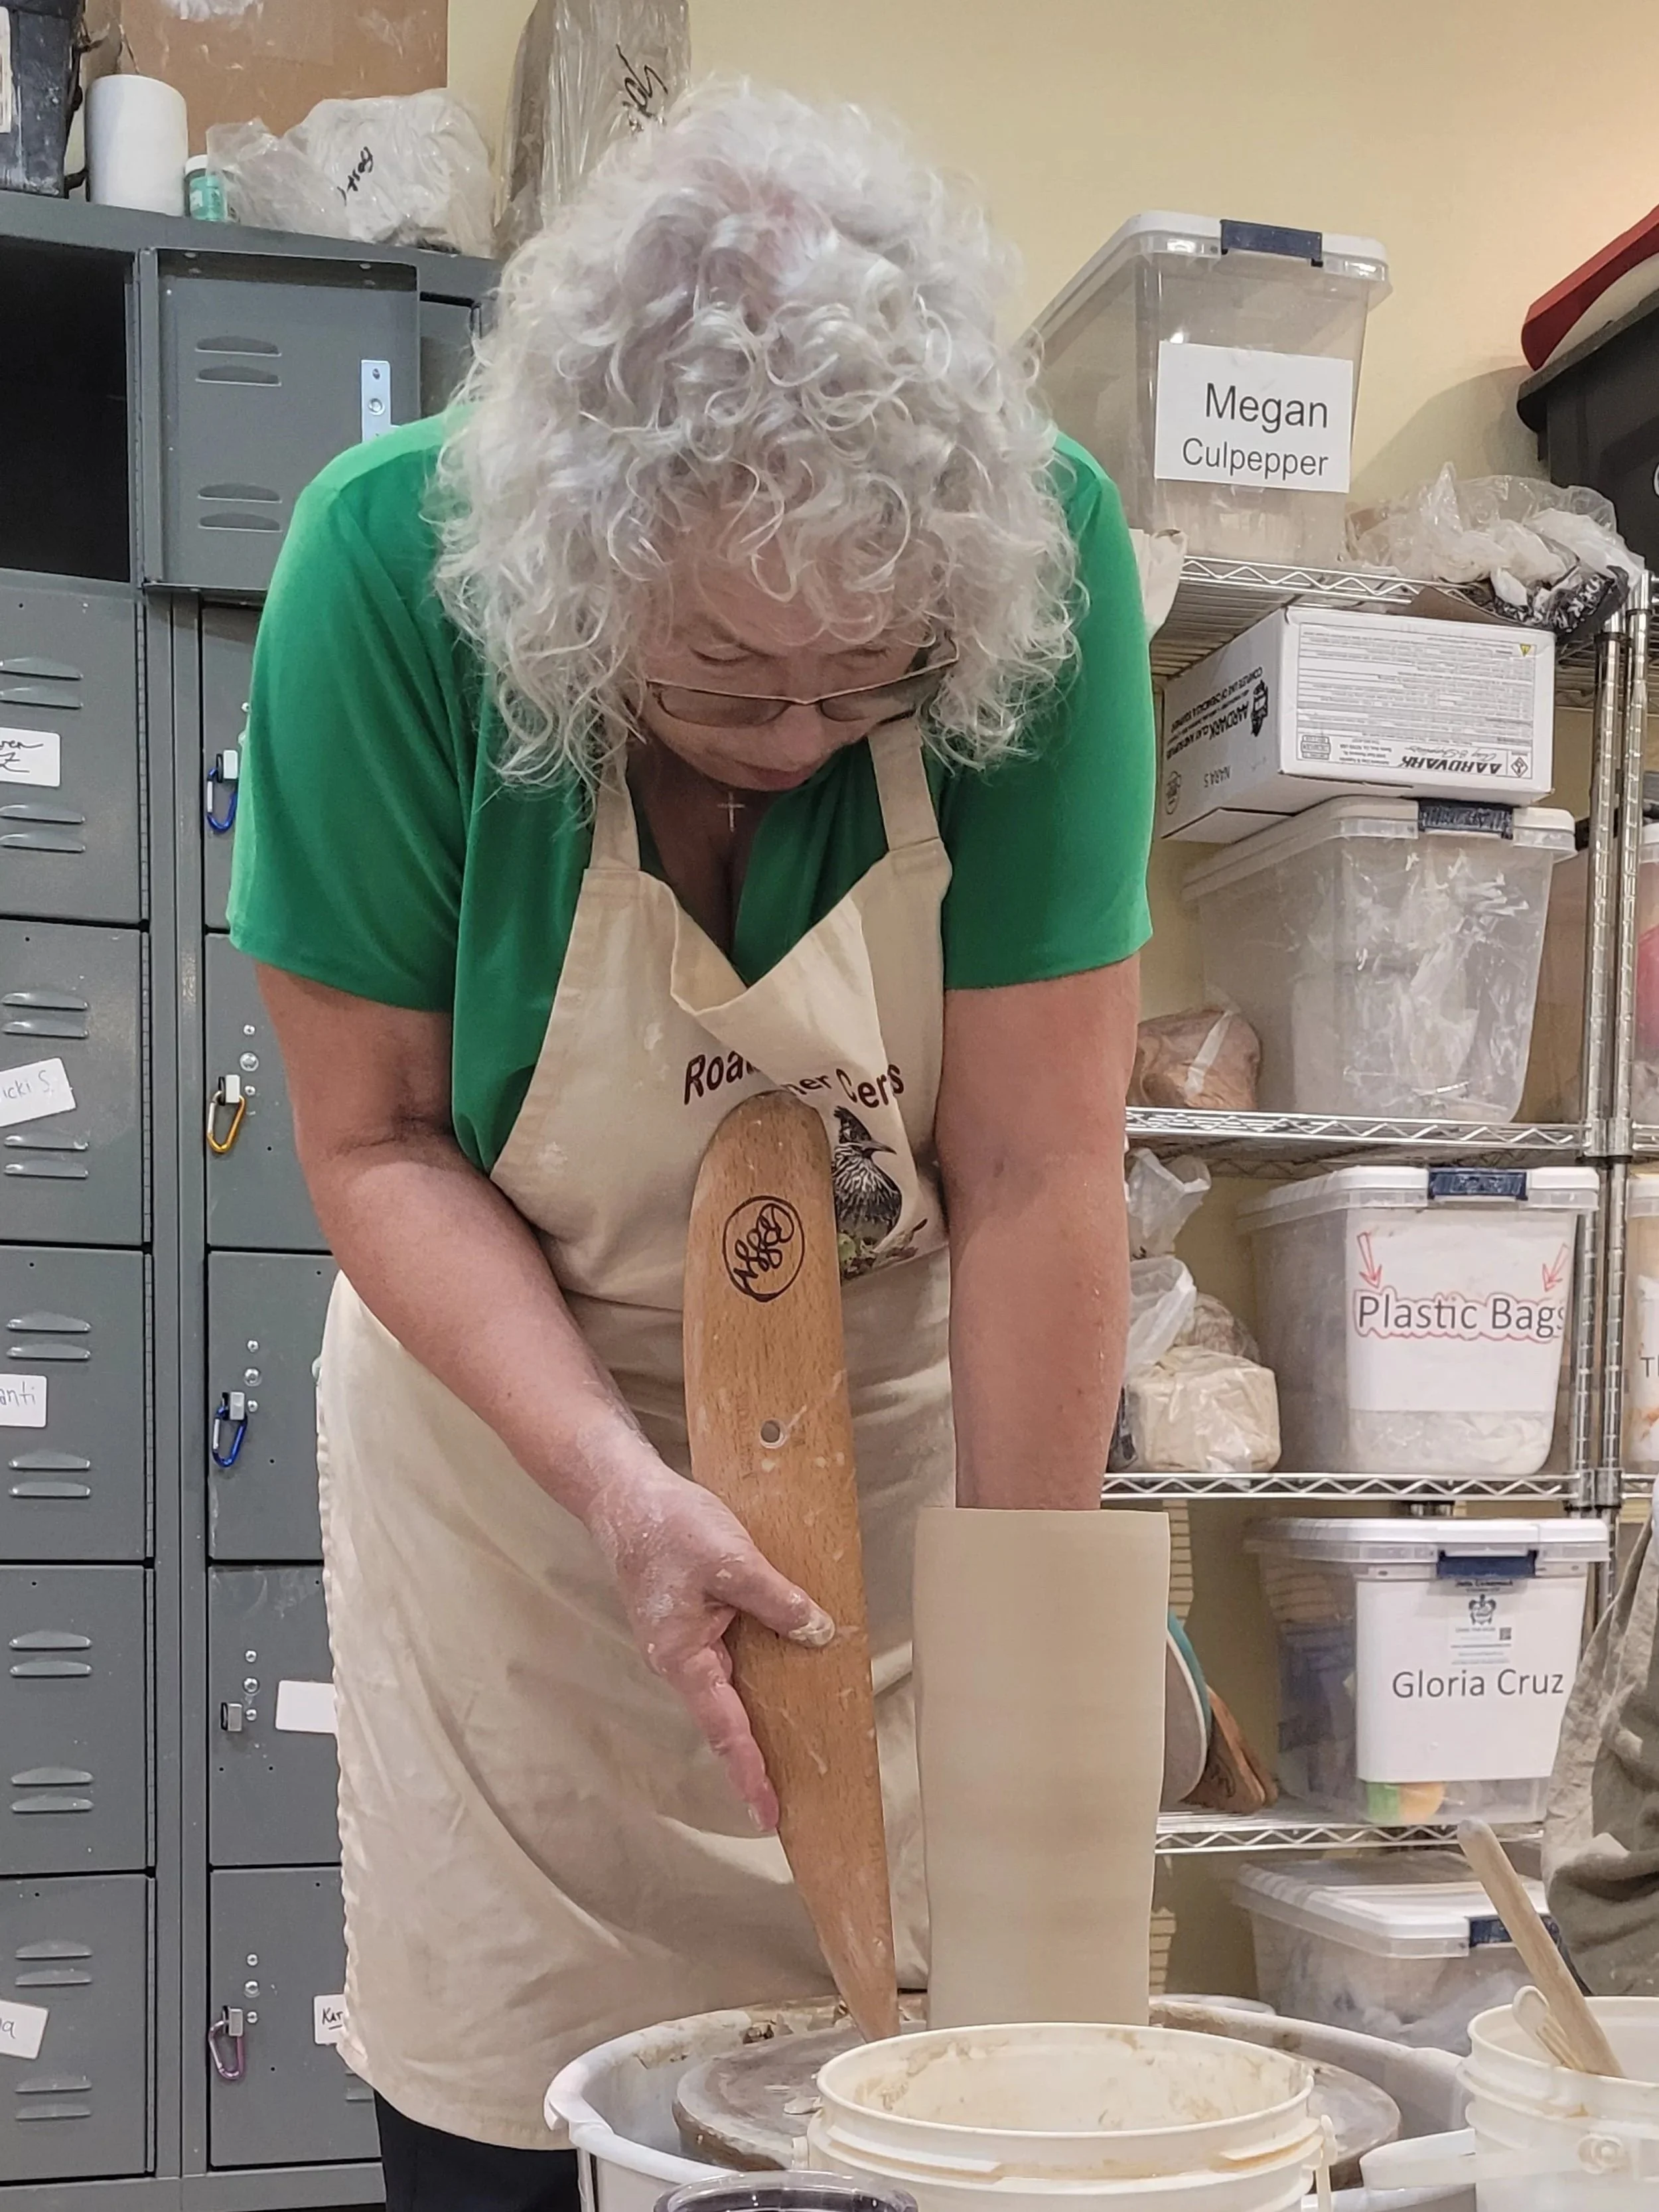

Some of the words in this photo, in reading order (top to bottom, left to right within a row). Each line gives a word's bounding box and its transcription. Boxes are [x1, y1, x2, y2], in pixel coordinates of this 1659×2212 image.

[1205, 382, 1328, 433] Megan
[1183, 437, 1329, 480] Culpepper
[1399, 756, 1502, 774] AARDVARK
[684, 1051, 762, 1106] Roa
[1358, 1293, 1478, 1329] Plastic
[1393, 1669, 1485, 1698] Gloria
[1497, 1669, 1564, 1696] Cruz
